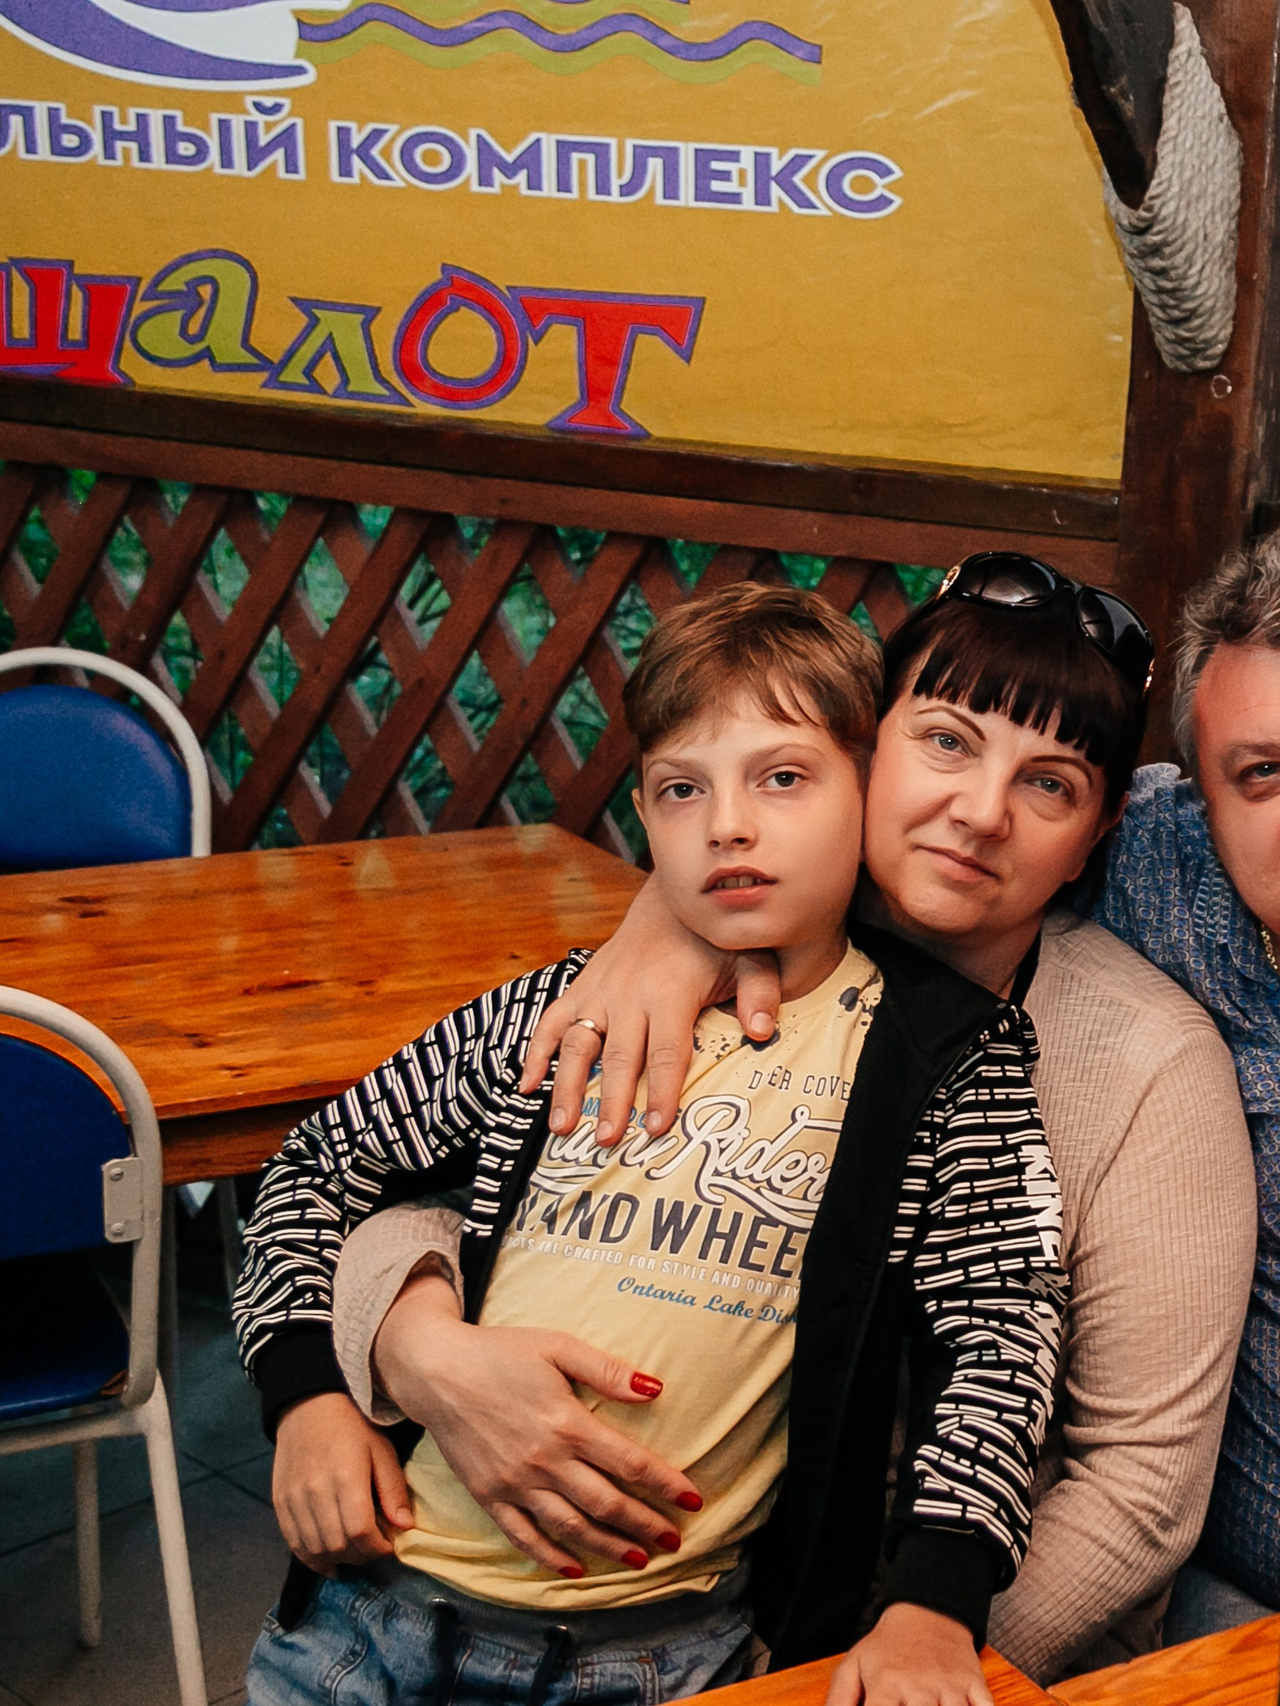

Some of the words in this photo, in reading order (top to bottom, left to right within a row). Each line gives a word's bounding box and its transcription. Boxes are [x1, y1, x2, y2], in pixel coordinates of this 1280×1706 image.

[328, 119, 904, 219] КОМПЛЕКС
[564, 1244, 623, 1265] CRAFTED
[628, 1254, 656, 1271] FOR
[661, 1260, 707, 1282] STYLE
[711, 1271, 741, 1288] AND
[649, 1197, 812, 1280] WHEE
[703, 1294, 754, 1318] Lake
